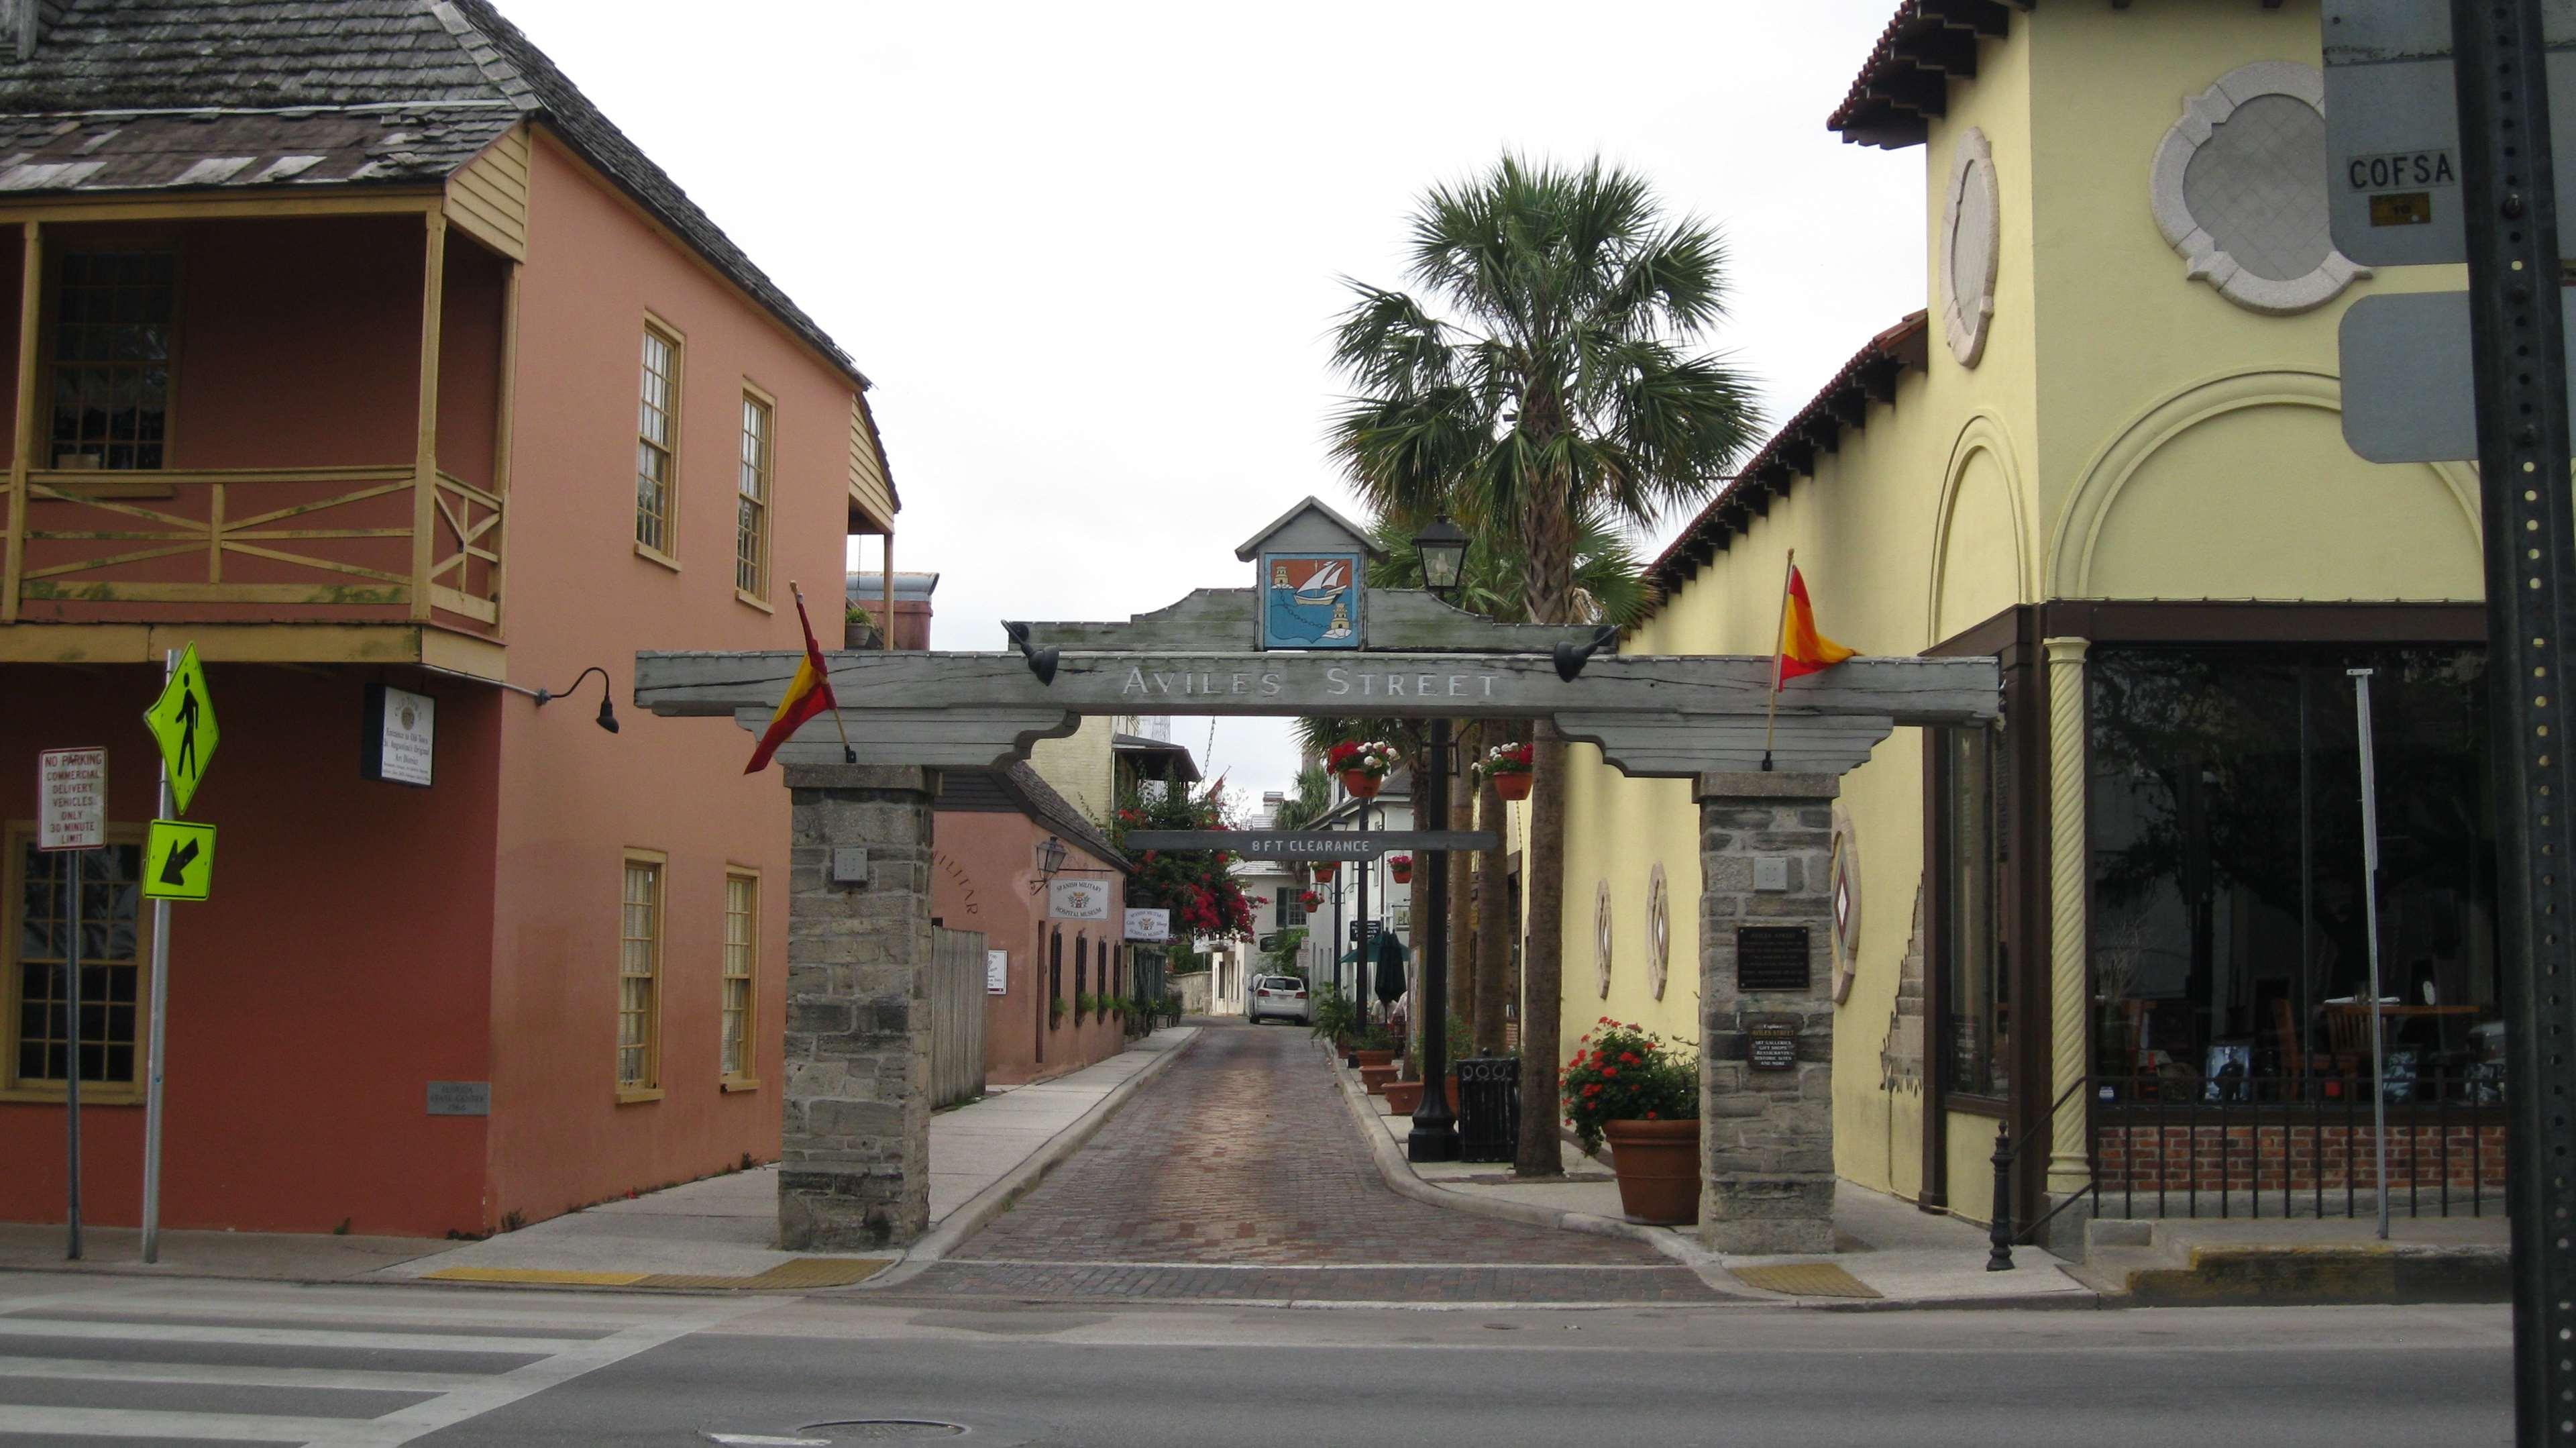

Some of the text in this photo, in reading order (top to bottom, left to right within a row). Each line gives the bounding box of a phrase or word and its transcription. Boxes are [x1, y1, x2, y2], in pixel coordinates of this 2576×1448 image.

[2350, 153, 2455, 189] COFSA
[1122, 666, 1499, 696] AVILES STREET
[44, 752, 103, 767] NO PARKING
[47, 770, 100, 781] COMMERCIAL
[53, 783, 93, 794] DELIVERY
[53, 796, 93, 807] VEHICLES
[61, 810, 83, 821] ONLY
[49, 821, 95, 833] 30 MINUTE
[61, 834, 83, 844] LIMIT
[1252, 840, 1260, 851] 8
[1289, 840, 1370, 851] CLEARANCE
[1057, 882, 1102, 892] SPANISH MILITARY
[1055, 906, 1102, 917] HOSPITAL MUSEUM
